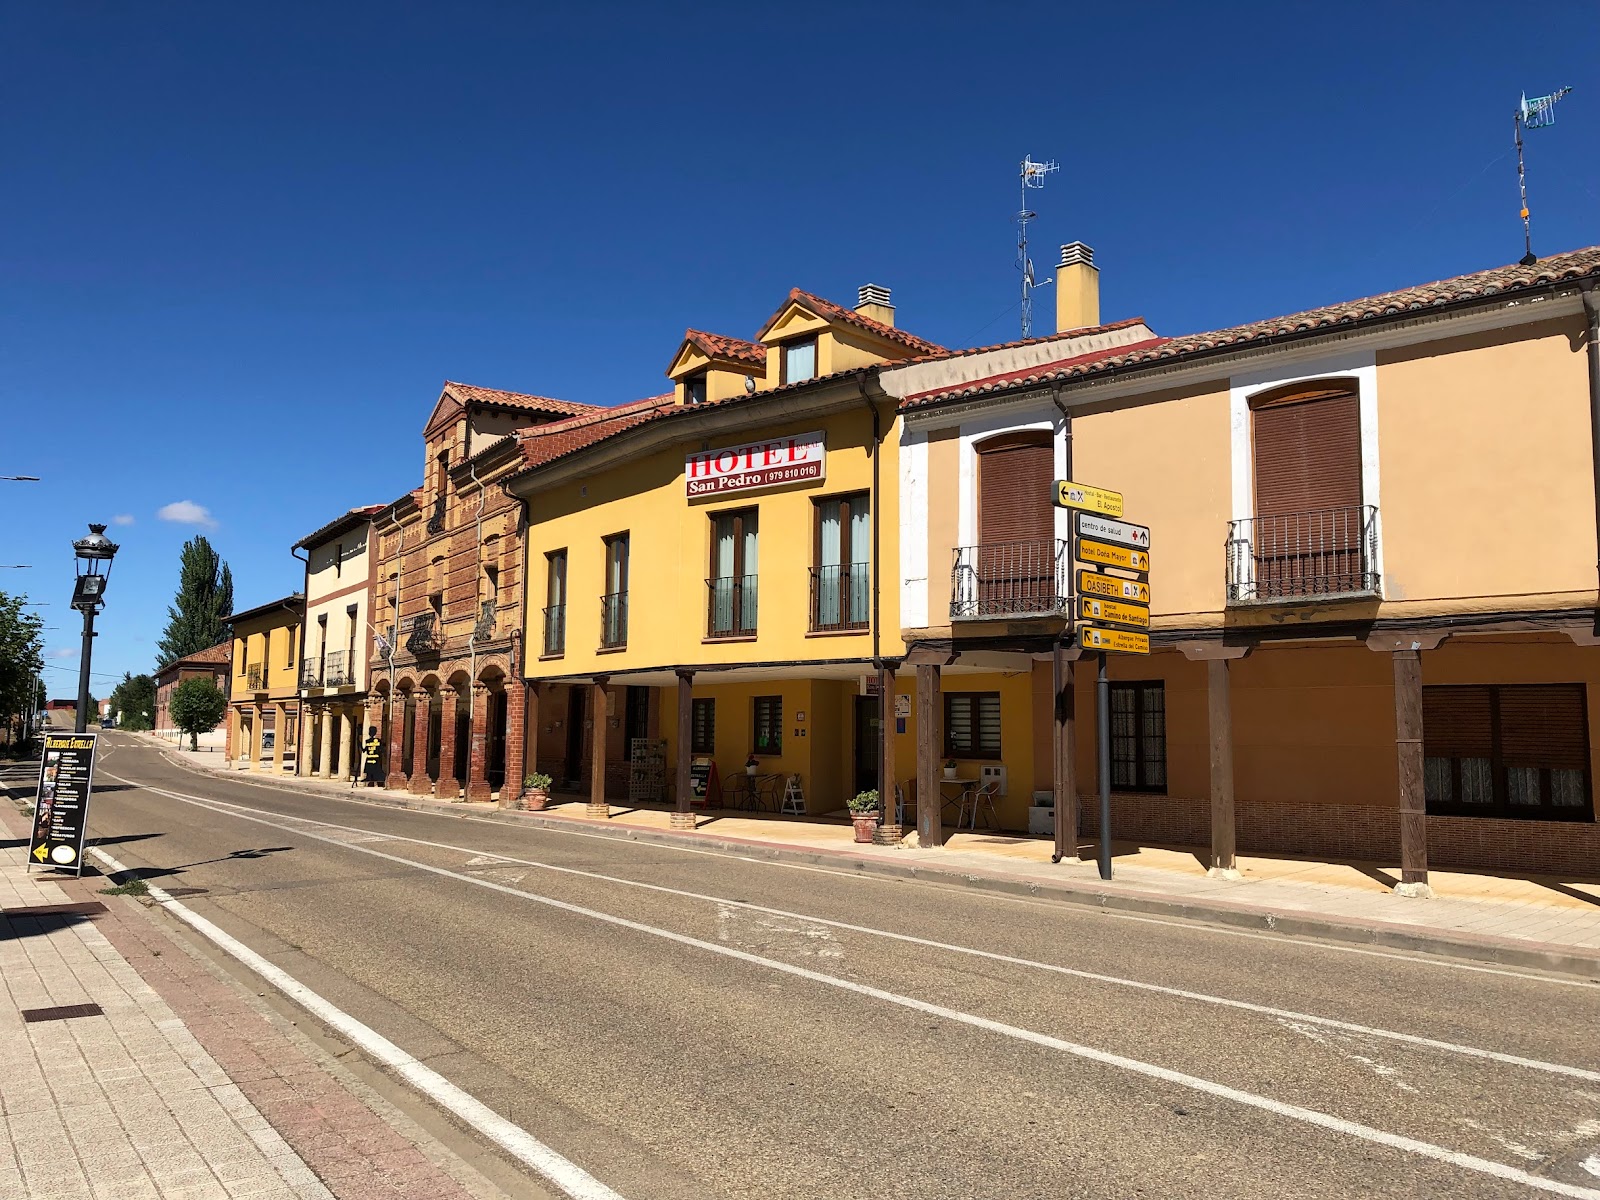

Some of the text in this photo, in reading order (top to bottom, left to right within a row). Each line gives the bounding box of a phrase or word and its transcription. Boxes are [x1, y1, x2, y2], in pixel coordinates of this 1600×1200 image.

[796, 442, 819, 451] RURAL
[690, 439, 808, 478] HOTEL
[689, 481, 715, 493] San
[719, 473, 761, 489] Pedro
[784, 468, 798, 479] 810
[800, 465, 817, 476] 016)
[1081, 522, 1122, 536] centro de salud
[1081, 546, 1095, 555] hotel
[1111, 552, 1127, 562] Mayor
[1086, 580, 1118, 596] OASIBETH
[1104, 609, 1147, 626] Camino de Santiago
[1118, 634, 1134, 642] Albergue
